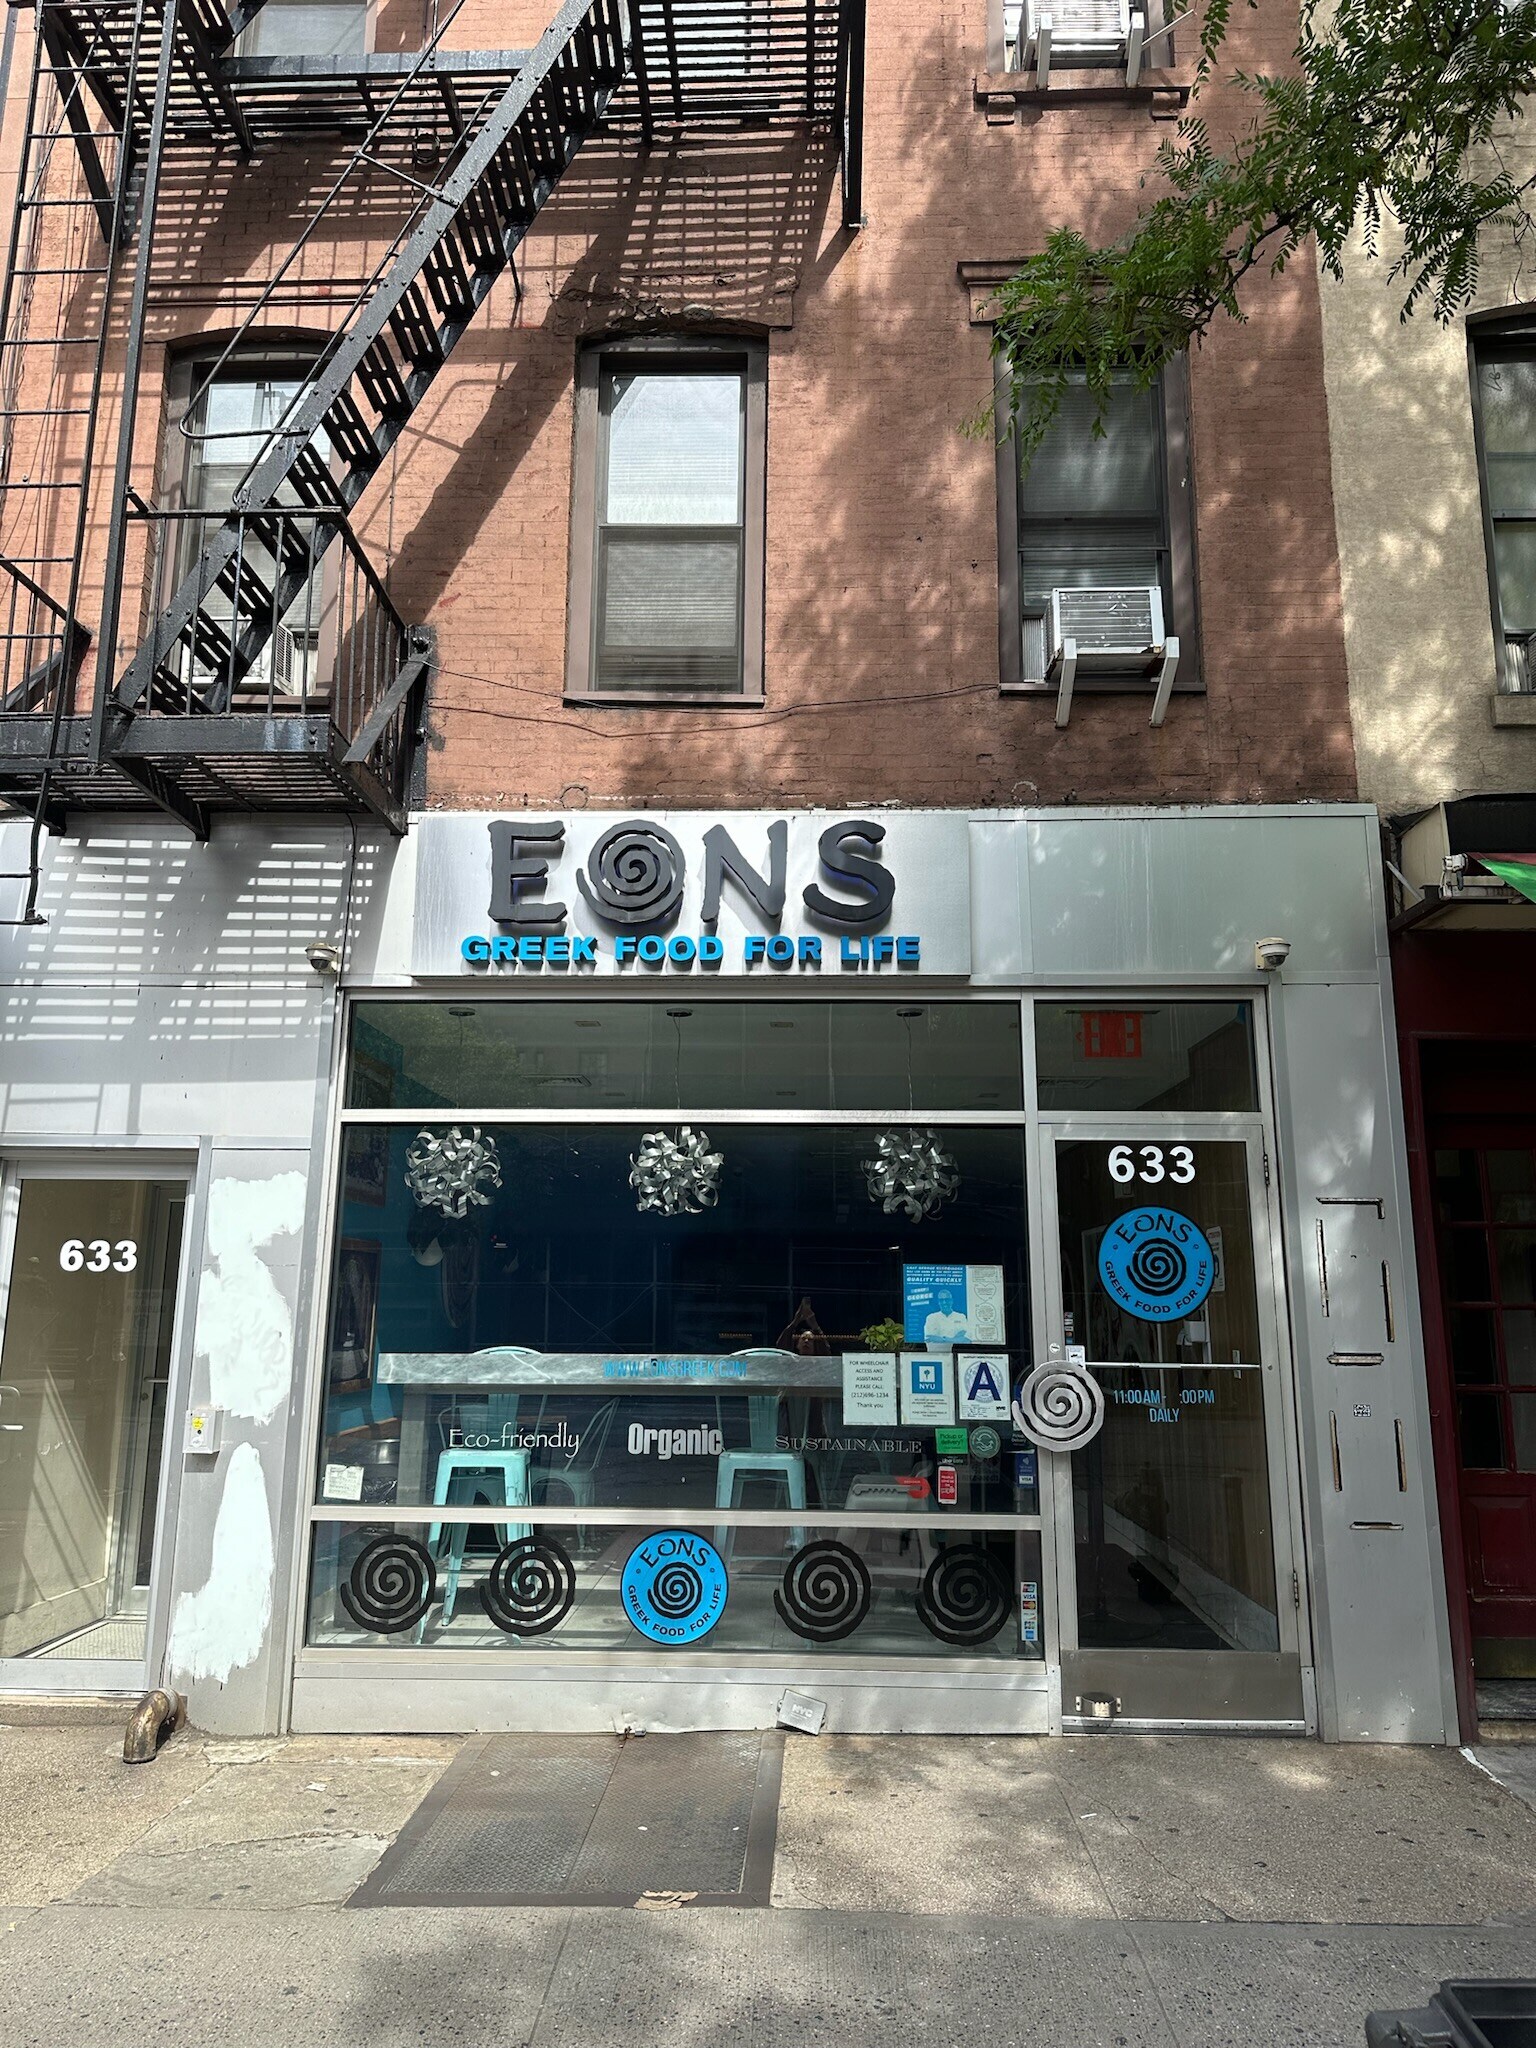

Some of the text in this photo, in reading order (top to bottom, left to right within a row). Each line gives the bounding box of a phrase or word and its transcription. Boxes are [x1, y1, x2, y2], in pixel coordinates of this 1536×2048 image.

[487, 819, 896, 925] EONS
[460, 935, 922, 963] GREEK FOOD FOR LIFE
[1108, 1145, 1197, 1184] 633
[1115, 1213, 1193, 1244] EONS
[59, 1239, 138, 1273] 633
[1105, 1260, 1207, 1314] GREEK FOOD FOR LIFE
[967, 1362, 1002, 1402] A
[1149, 1408, 1180, 1423] DAILY
[449, 1422, 580, 1458] Eco-friendly
[627, 1422, 725, 1460] Organic
[774, 1435, 922, 1453] SUSTAINABLE
[639, 1537, 711, 1569] EONS
[628, 1583, 722, 1637] GREEK FOOD FOR LIFE
[792, 1704, 814, 1718] NYC
